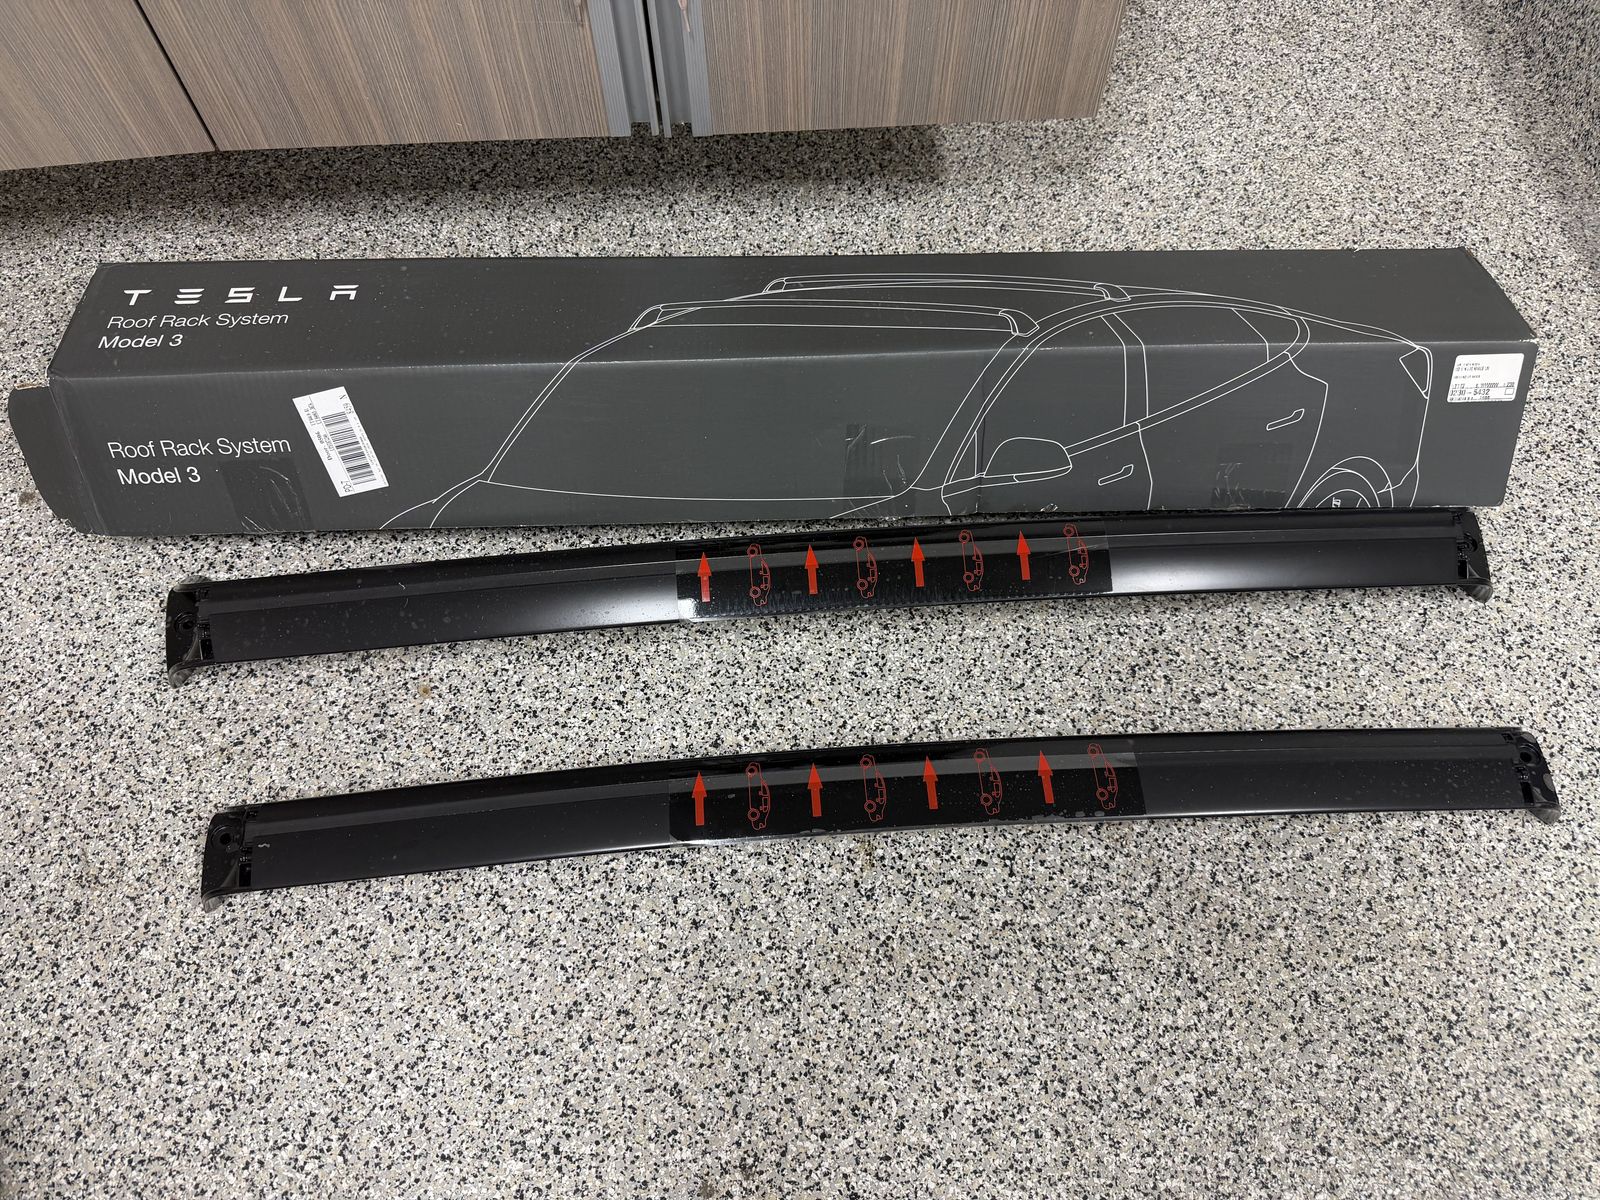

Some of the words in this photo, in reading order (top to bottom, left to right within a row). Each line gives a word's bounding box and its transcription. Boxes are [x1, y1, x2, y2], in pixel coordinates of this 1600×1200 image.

[124, 285, 359, 305] TESLA
[107, 316, 157, 329] Roof
[160, 314, 211, 328] Rack
[216, 313, 289, 328] System
[98, 335, 164, 349] Model
[169, 333, 184, 347] 3
[107, 441, 155, 459] Roof
[160, 439, 214, 457] Rack
[216, 437, 292, 458] System
[116, 467, 182, 485] Model
[186, 466, 201, 483] 3
